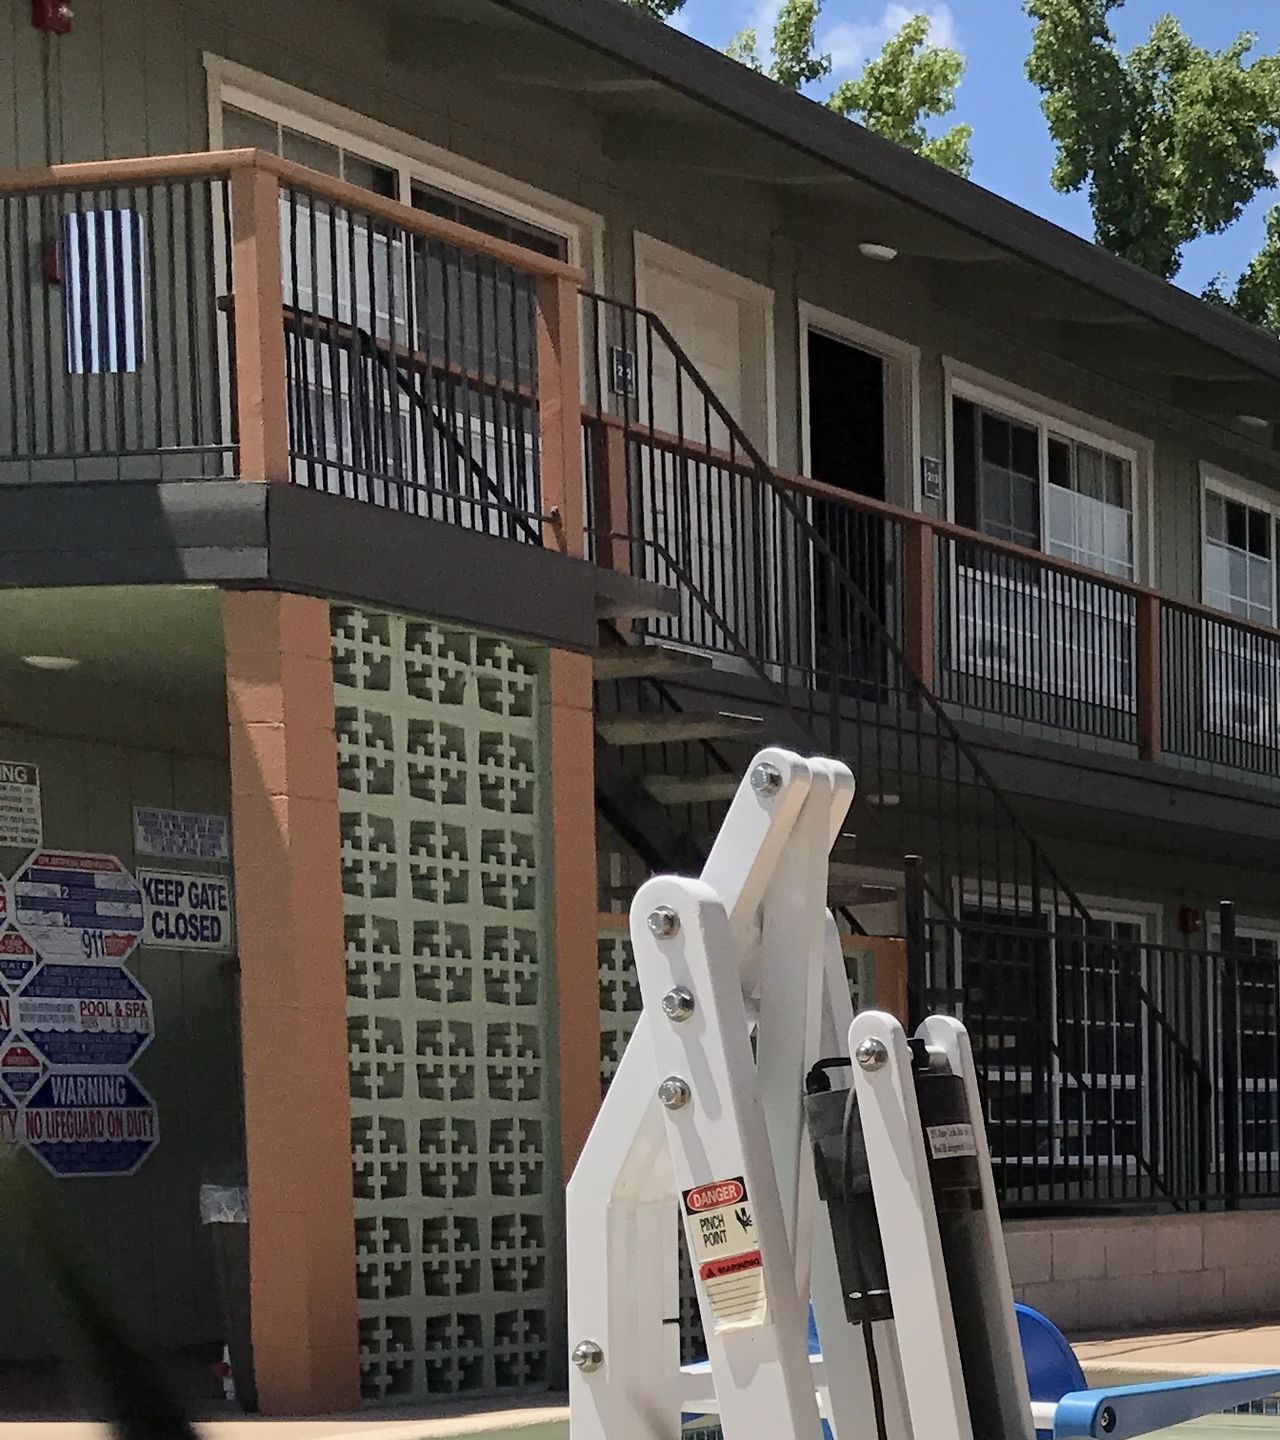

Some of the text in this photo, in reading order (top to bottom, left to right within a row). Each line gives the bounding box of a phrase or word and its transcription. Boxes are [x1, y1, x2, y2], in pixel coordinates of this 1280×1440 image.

[618, 365, 631, 379] 22
[0, 766, 27, 782] NG
[143, 877, 228, 912] KEEP GATE
[151, 910, 221, 943] CLOSED
[82, 929, 105, 959] 911
[80, 1000, 113, 1017] POOL
[115, 1002, 122, 1018] &
[125, 1002, 148, 1018] SPA
[51, 1075, 126, 1106] WARNING
[26, 1110, 154, 1139] NO LIFEGUARD ON DUTY
[693, 1184, 738, 1208] DANGER
[699, 1214, 726, 1233] PINCH
[702, 1230, 728, 1248] POINT
[717, 1258, 761, 1274] WARNING
